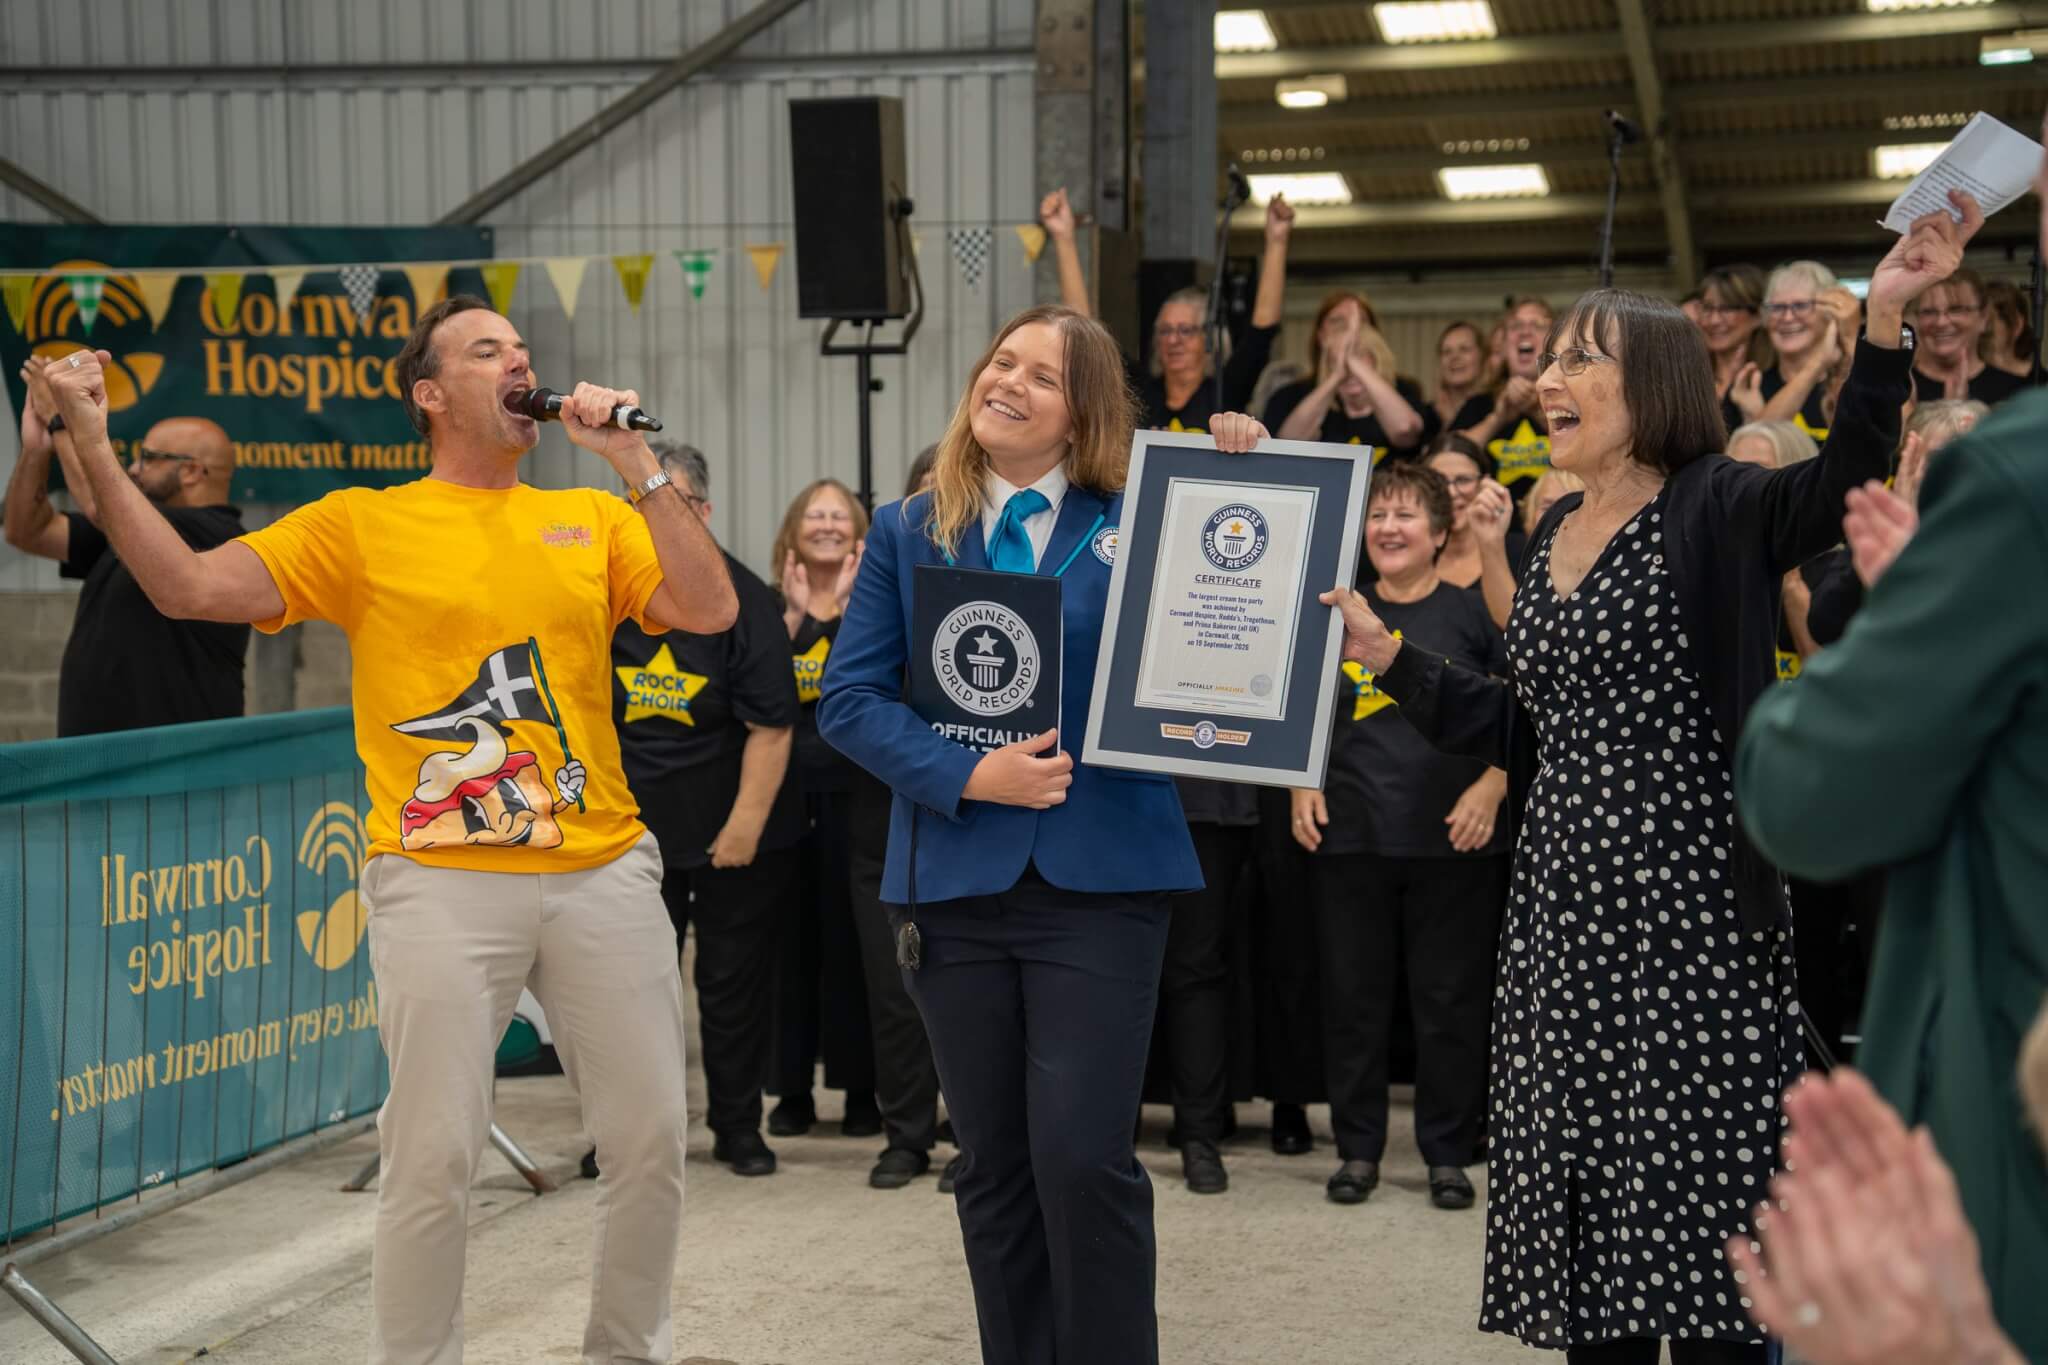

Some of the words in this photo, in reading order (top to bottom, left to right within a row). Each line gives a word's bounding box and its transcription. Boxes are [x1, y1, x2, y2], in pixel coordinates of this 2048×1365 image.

[352, 442, 433, 470] matt
[1213, 507, 1262, 528] GUINNESS
[1205, 531, 1224, 565] WORLD
[1225, 535, 1265, 568] RECORDS
[1194, 574, 1262, 588] CERTIFICATE
[1199, 593, 1218, 602] largest
[1248, 597, 1263, 606] party
[1169, 609, 1193, 617] Cornwall
[1213, 604, 1237, 612] achieved
[1239, 606, 1246, 614] by
[950, 609, 1025, 641] GUINNESS
[1212, 622, 1237, 631] Bakeries
[1238, 624, 1248, 632] (all
[1249, 625, 1259, 633] UK)
[1203, 640, 1233, 650] September
[633, 672, 688, 695] ROCK
[940, 648, 973, 702] WORLD
[979, 655, 1033, 709] RECORDS
[1177, 681, 1213, 690] OFFICIALLY
[624, 691, 691, 712] CHOIR
[1166, 727, 1194, 737] RECORD
